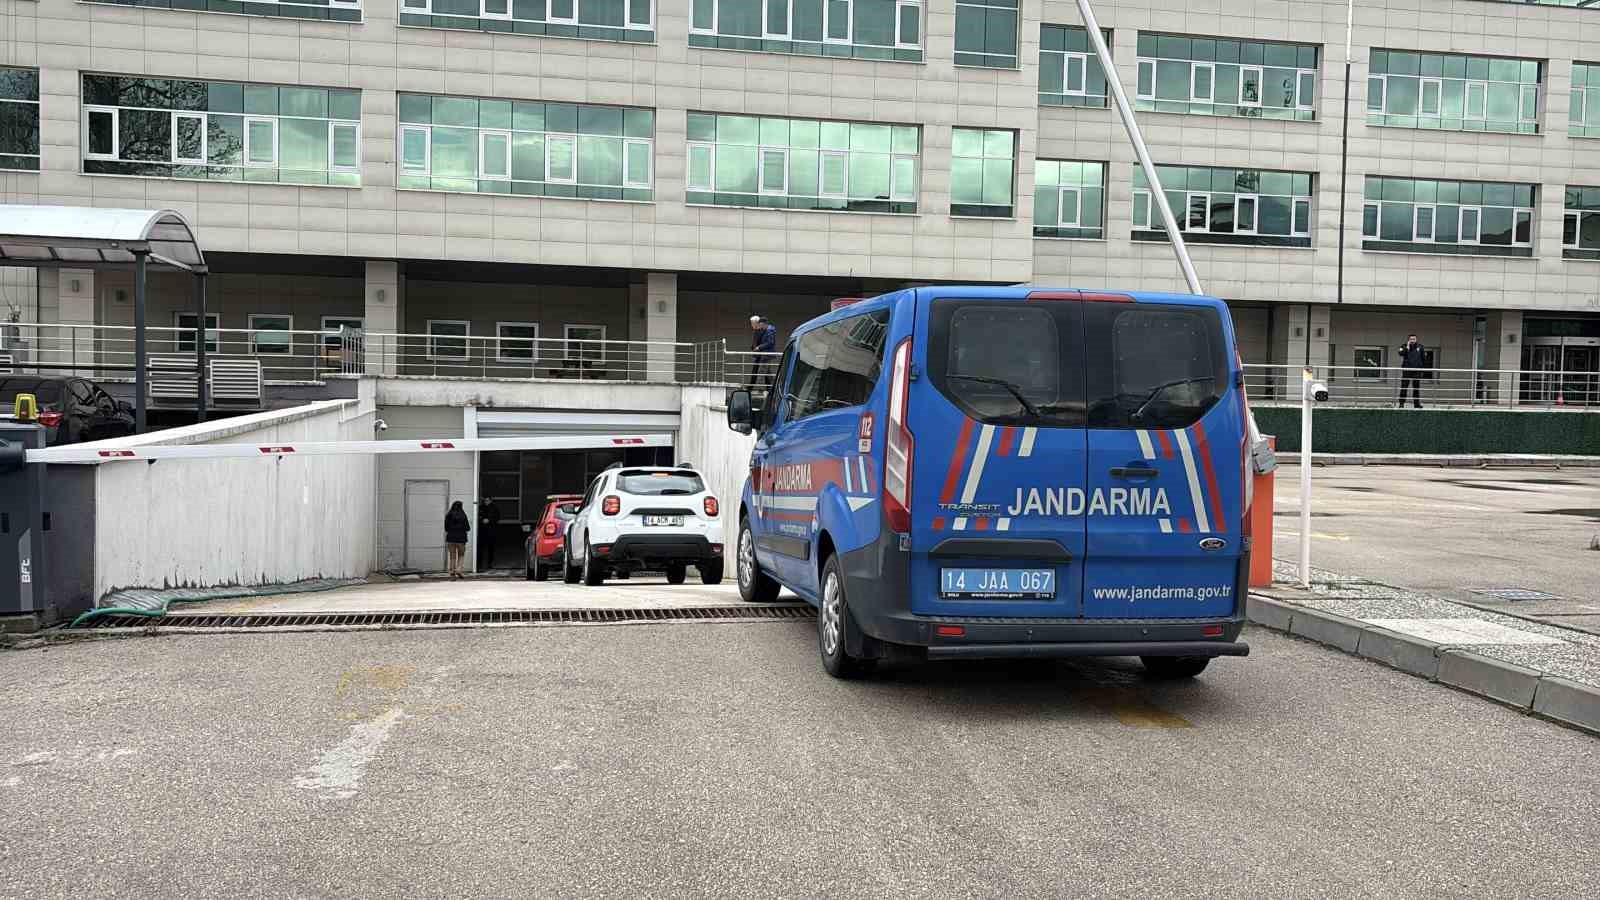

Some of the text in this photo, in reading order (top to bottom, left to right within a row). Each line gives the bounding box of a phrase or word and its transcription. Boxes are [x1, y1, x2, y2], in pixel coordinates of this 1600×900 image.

[861, 415, 872, 437] 112
[774, 463, 812, 490] JANDARMA
[1007, 487, 1172, 516] JANDARMA
[947, 571, 1052, 590] 14 JAA 067
[1093, 585, 1231, 602] www.jandarma.gov.tr
